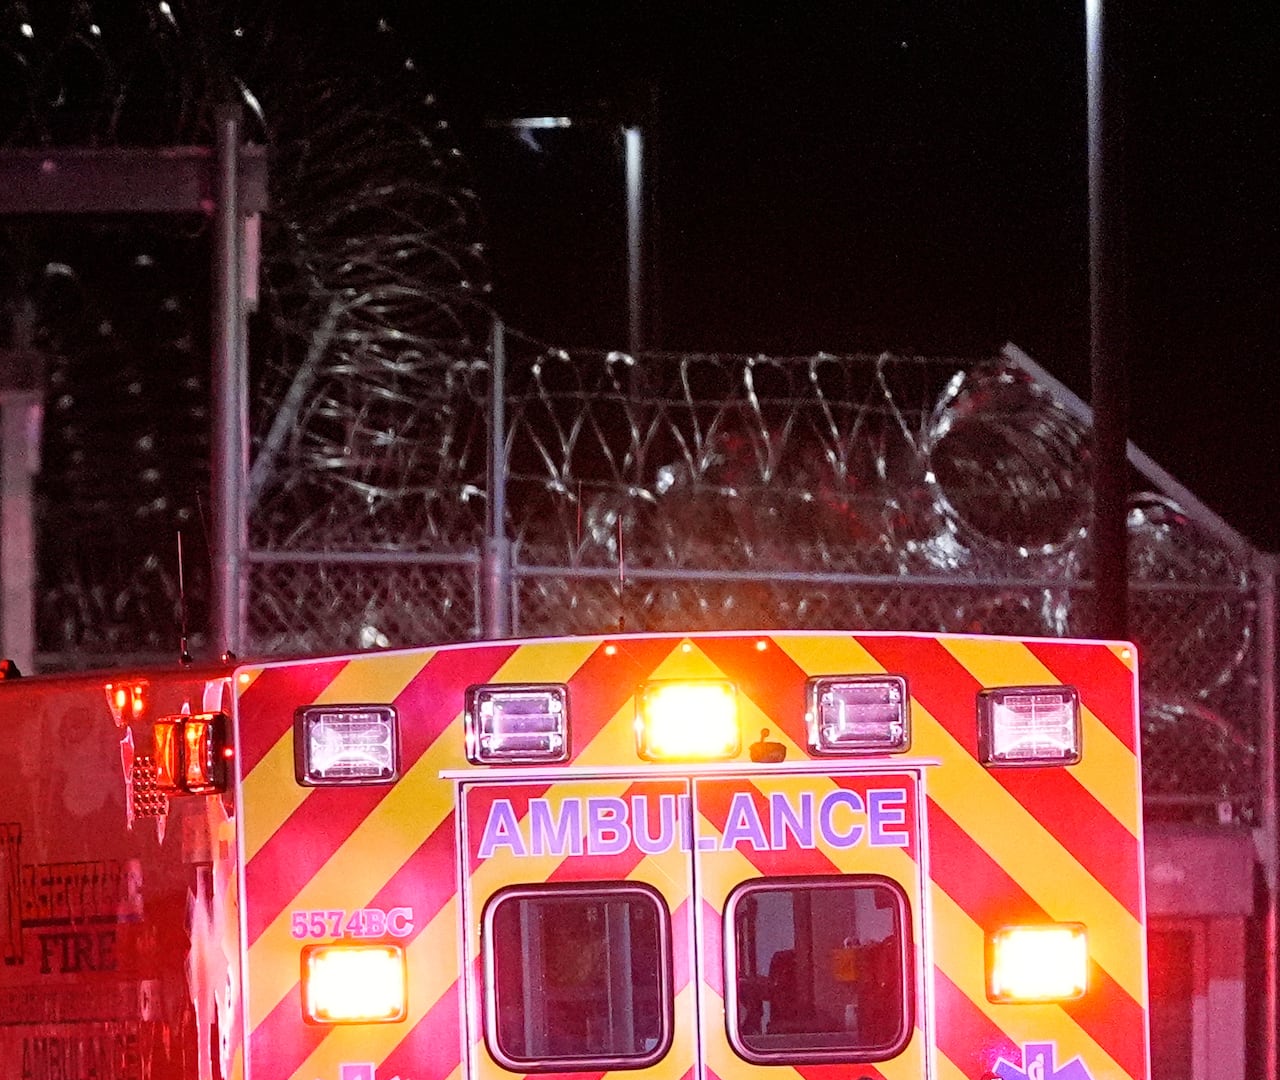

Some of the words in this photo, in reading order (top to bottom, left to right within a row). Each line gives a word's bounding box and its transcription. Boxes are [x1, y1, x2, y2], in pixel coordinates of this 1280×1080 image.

[477, 788, 910, 858] AMBULANCE
[290, 907, 415, 939] 5574BC
[38, 930, 117, 975] FIRE
